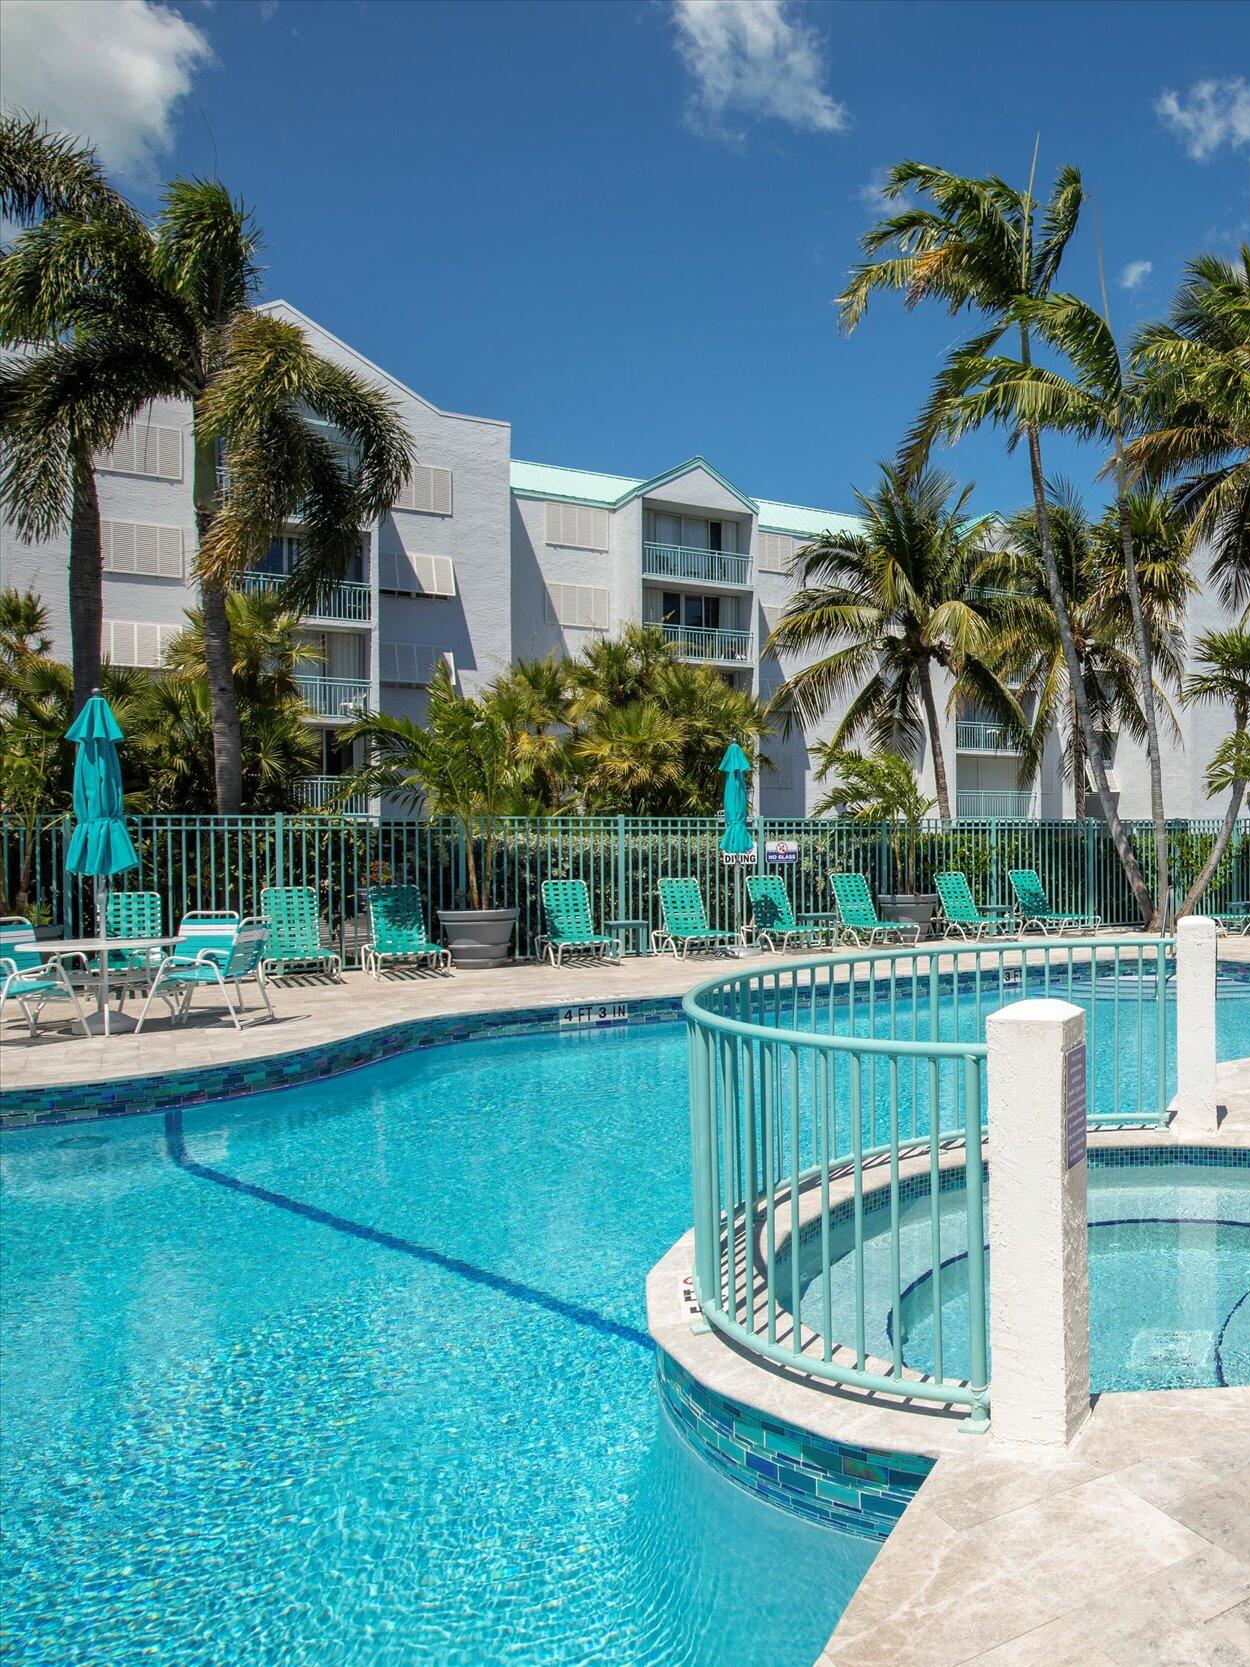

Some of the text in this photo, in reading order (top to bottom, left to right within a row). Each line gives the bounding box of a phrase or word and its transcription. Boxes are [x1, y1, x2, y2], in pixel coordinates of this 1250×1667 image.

[1005, 972, 1010, 981] 3
[564, 1005, 625, 1022] 4 FT 3 IN
